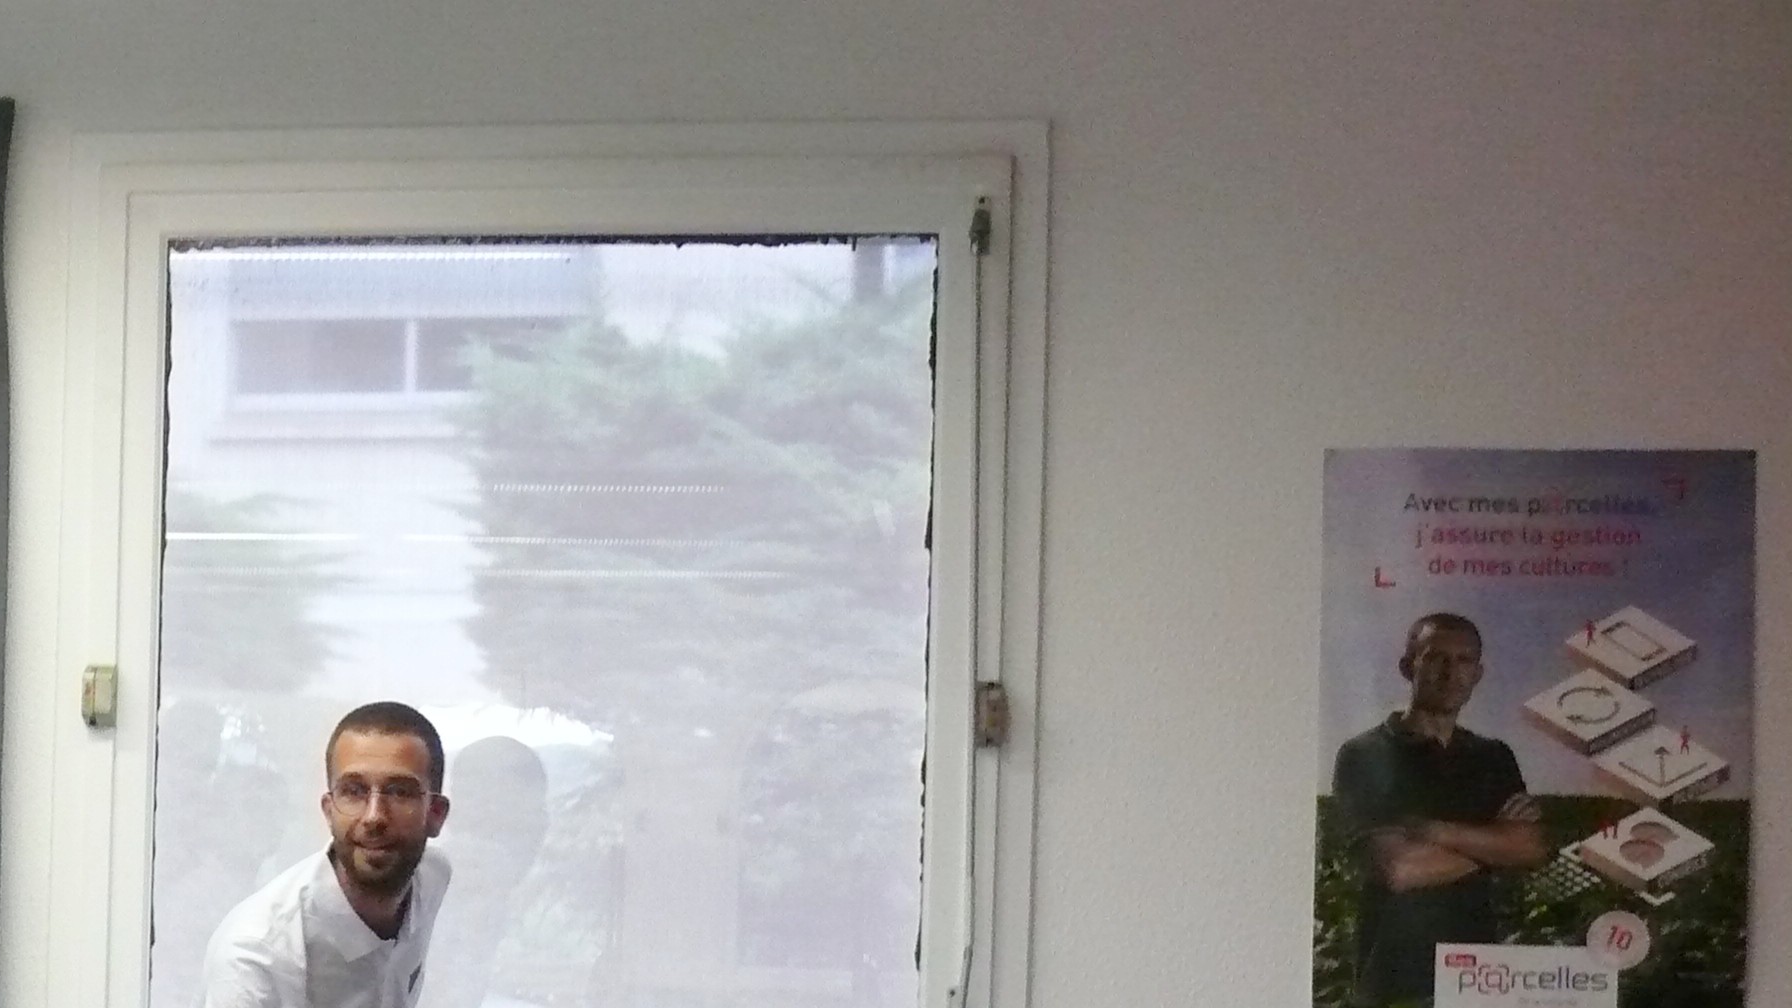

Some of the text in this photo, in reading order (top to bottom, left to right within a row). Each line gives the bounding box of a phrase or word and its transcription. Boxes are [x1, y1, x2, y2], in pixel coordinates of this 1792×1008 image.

[1403, 493, 1460, 514] Avec
[1468, 499, 1520, 514] mes
[1415, 523, 1643, 549] j'assure la gestion
[1428, 556, 1457, 576] de
[1463, 559, 1512, 577] mes
[1518, 557, 1615, 577] cultures
[1606, 925, 1633, 951] 10
